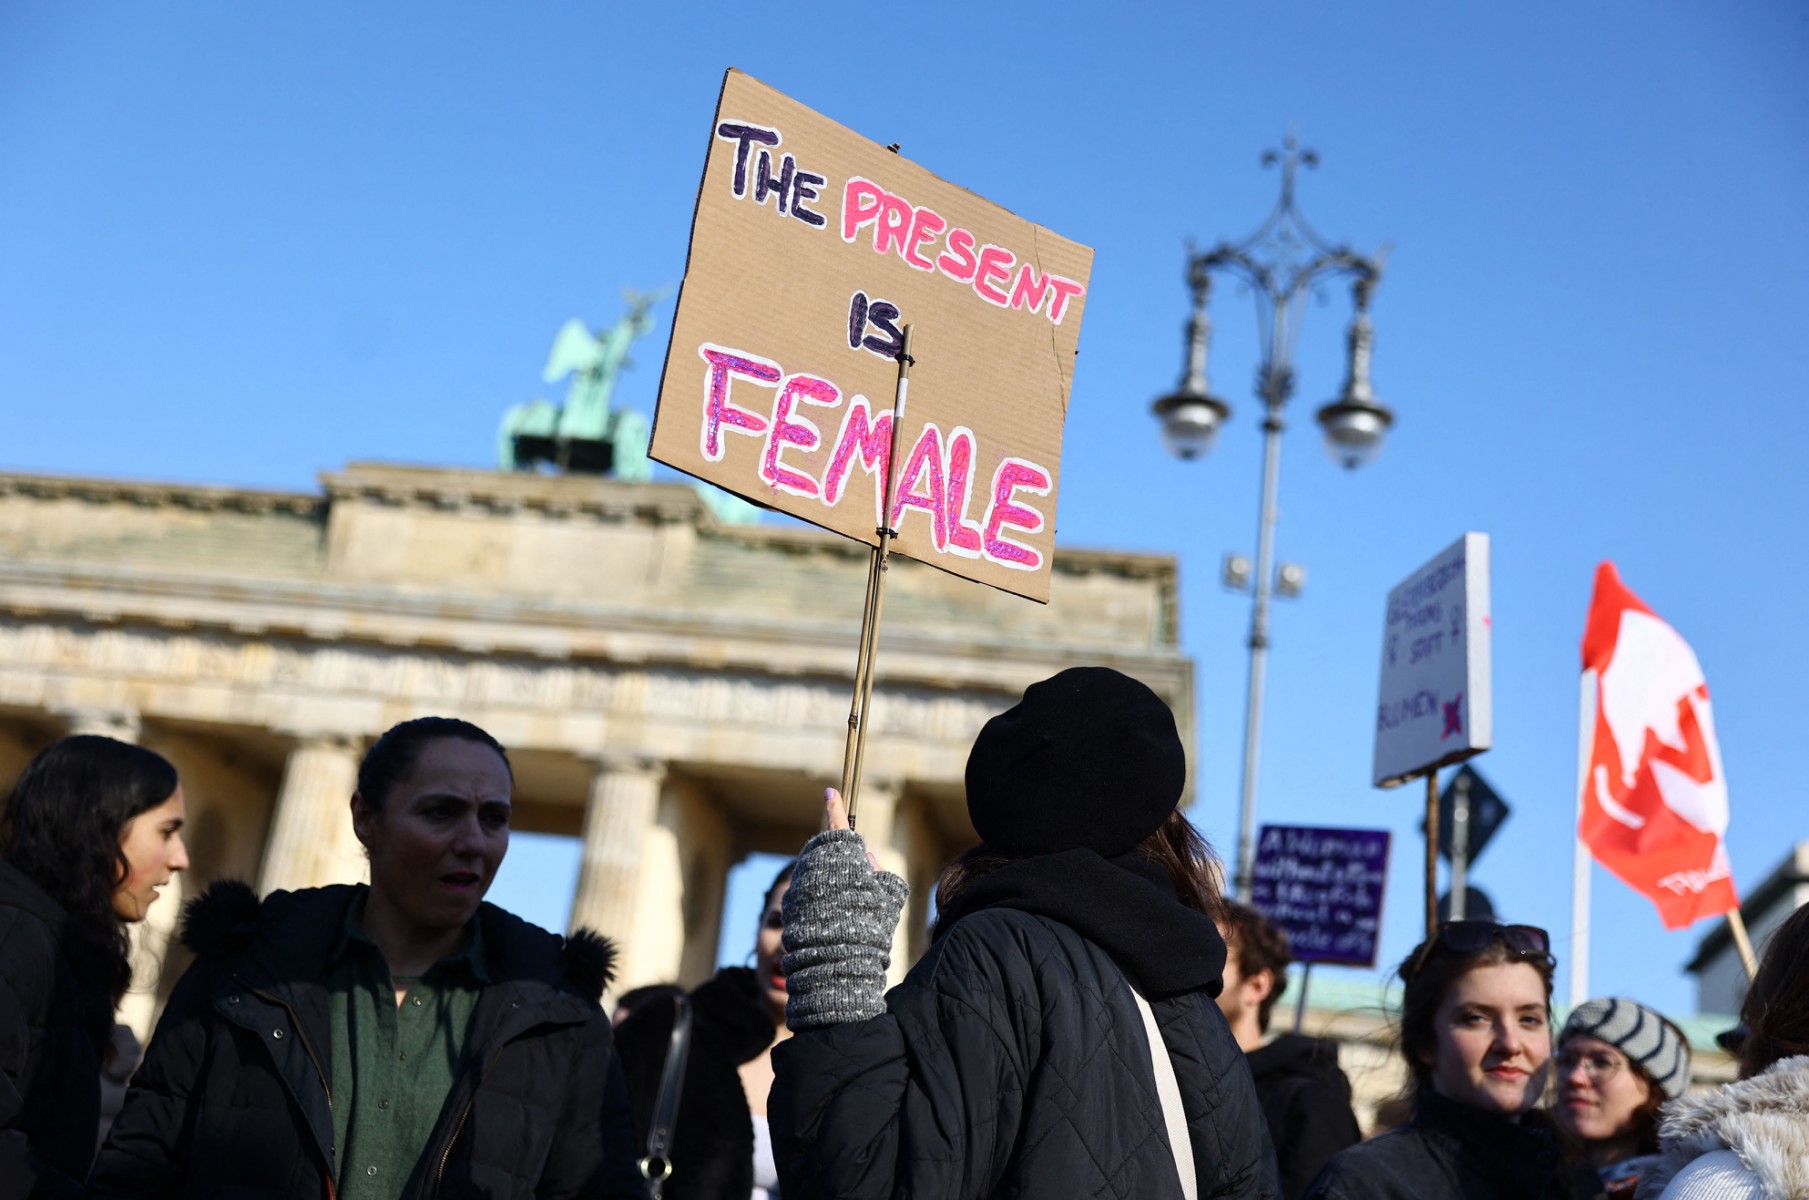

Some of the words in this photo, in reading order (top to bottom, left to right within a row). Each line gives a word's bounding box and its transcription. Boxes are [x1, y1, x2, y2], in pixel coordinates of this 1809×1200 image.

[717, 119, 827, 229] THE
[841, 175, 1085, 324] PRESENT
[847, 290, 903, 359] IS
[699, 343, 1052, 571] FEMALE
